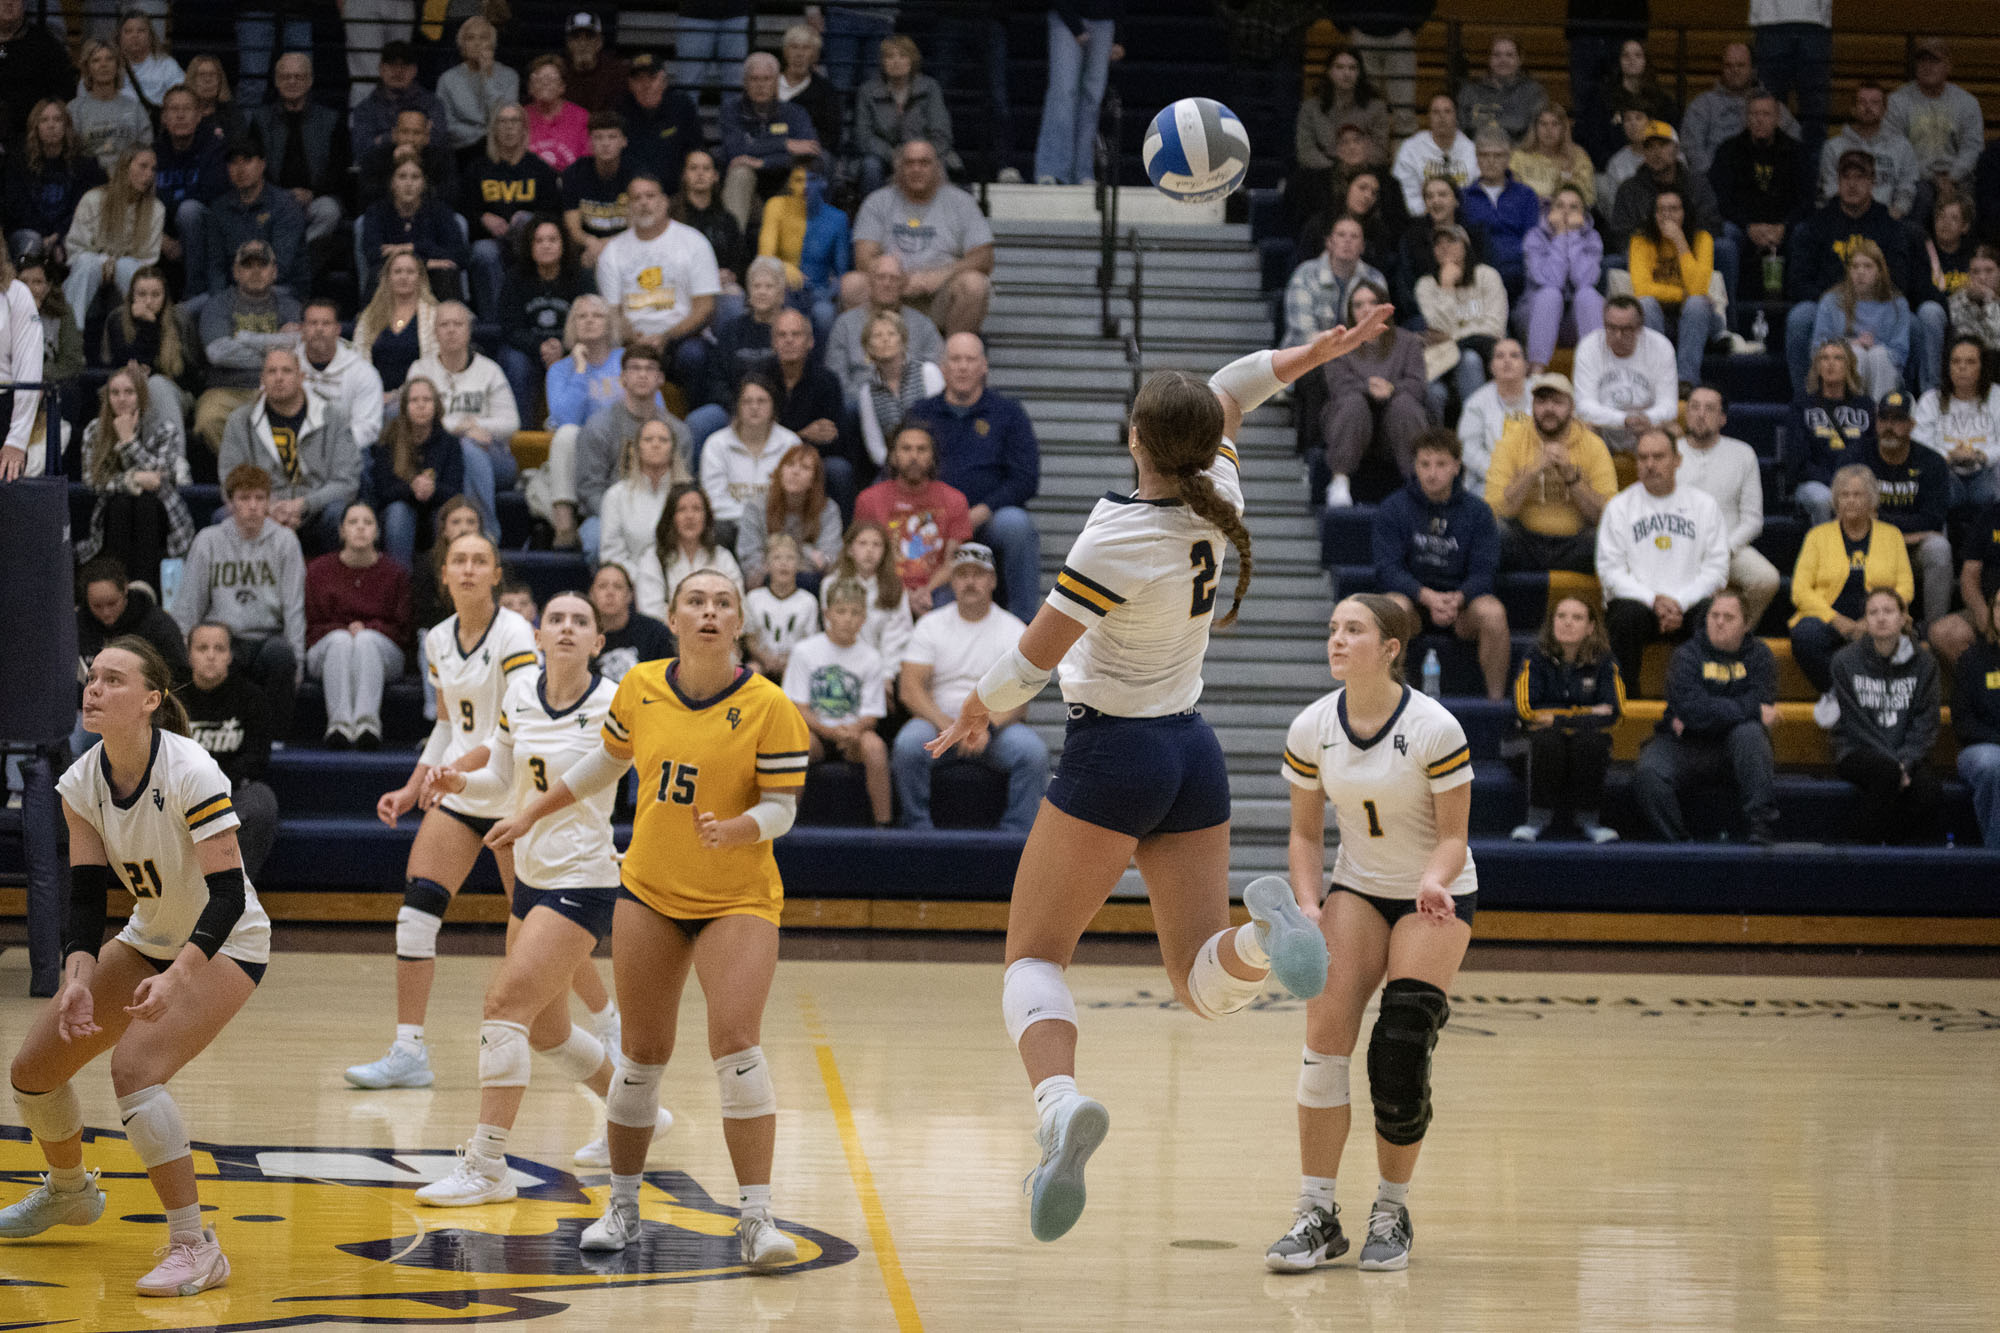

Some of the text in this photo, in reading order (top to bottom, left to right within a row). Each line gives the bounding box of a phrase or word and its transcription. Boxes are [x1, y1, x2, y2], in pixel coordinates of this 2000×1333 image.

[481, 179, 536, 203] BVU
[1632, 513, 1696, 543] BEAVERS
[213, 560, 276, 587] IOWA
[1190, 539, 1216, 618] 2
[460, 698, 474, 734] 9
[529, 755, 548, 792] 3
[656, 760, 698, 805] 15
[1363, 799, 1384, 838] 1
[122, 858, 162, 899] 21
